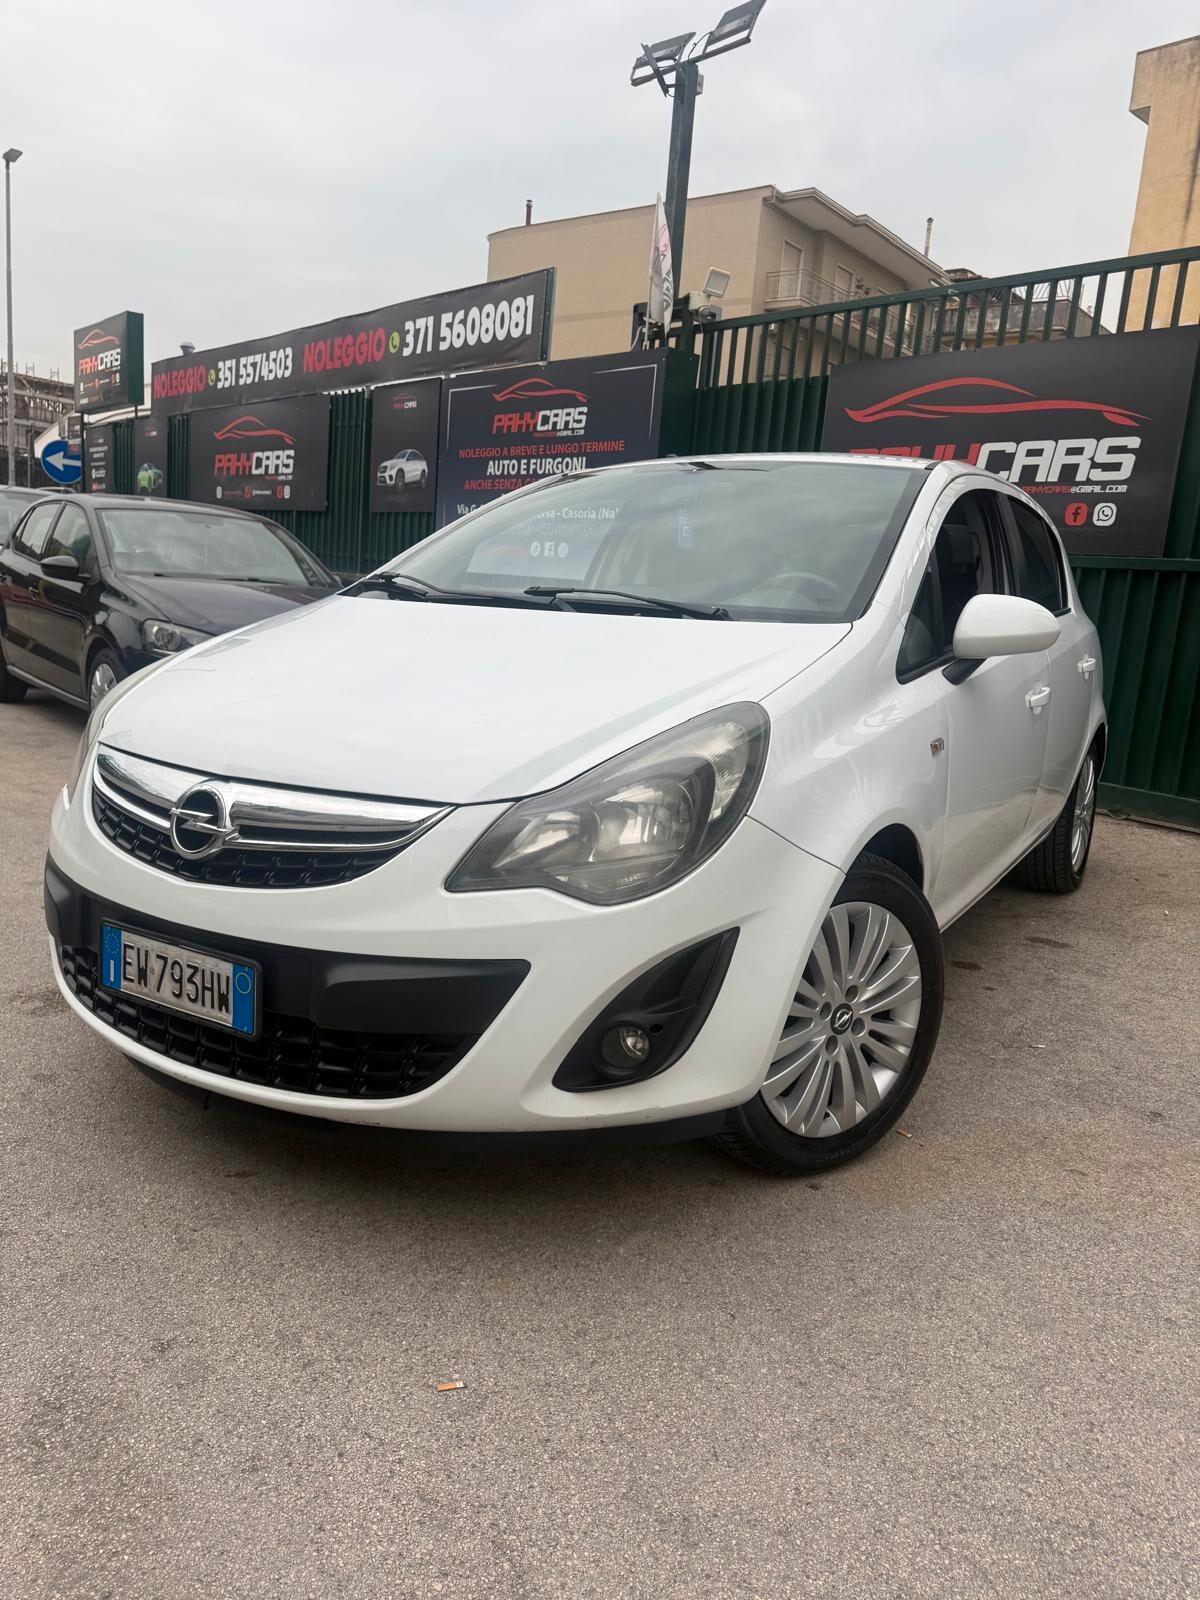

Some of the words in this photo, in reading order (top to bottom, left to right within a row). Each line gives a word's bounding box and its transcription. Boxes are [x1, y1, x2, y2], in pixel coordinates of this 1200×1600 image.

[303, 327, 386, 373] NOLEGGIO
[403, 316, 434, 356] 371
[439, 295, 535, 351] 5608081
[153, 364, 206, 400] NOLEGGIO
[217, 358, 236, 389] 351
[239, 346, 293, 386] 5574503
[459, 447, 500, 458] NOLEGGIO
[502, 448, 508, 457] A
[510, 445, 538, 456] BREVE
[539, 444, 544, 455] E
[546, 442, 579, 454] LUNGO
[580, 440, 625, 452] TERMINE
[486, 458, 518, 476] AUTO
[520, 458, 527, 475] E
[529, 456, 586, 475] FURGONI
[464, 480, 494, 490] ANCHE
[495, 479, 522, 489] SENZA
[457, 504, 469, 515] Via
[562, 507, 596, 519] Casoria
[122, 942, 149, 988] EW
[156, 953, 230, 1013] 793HW
